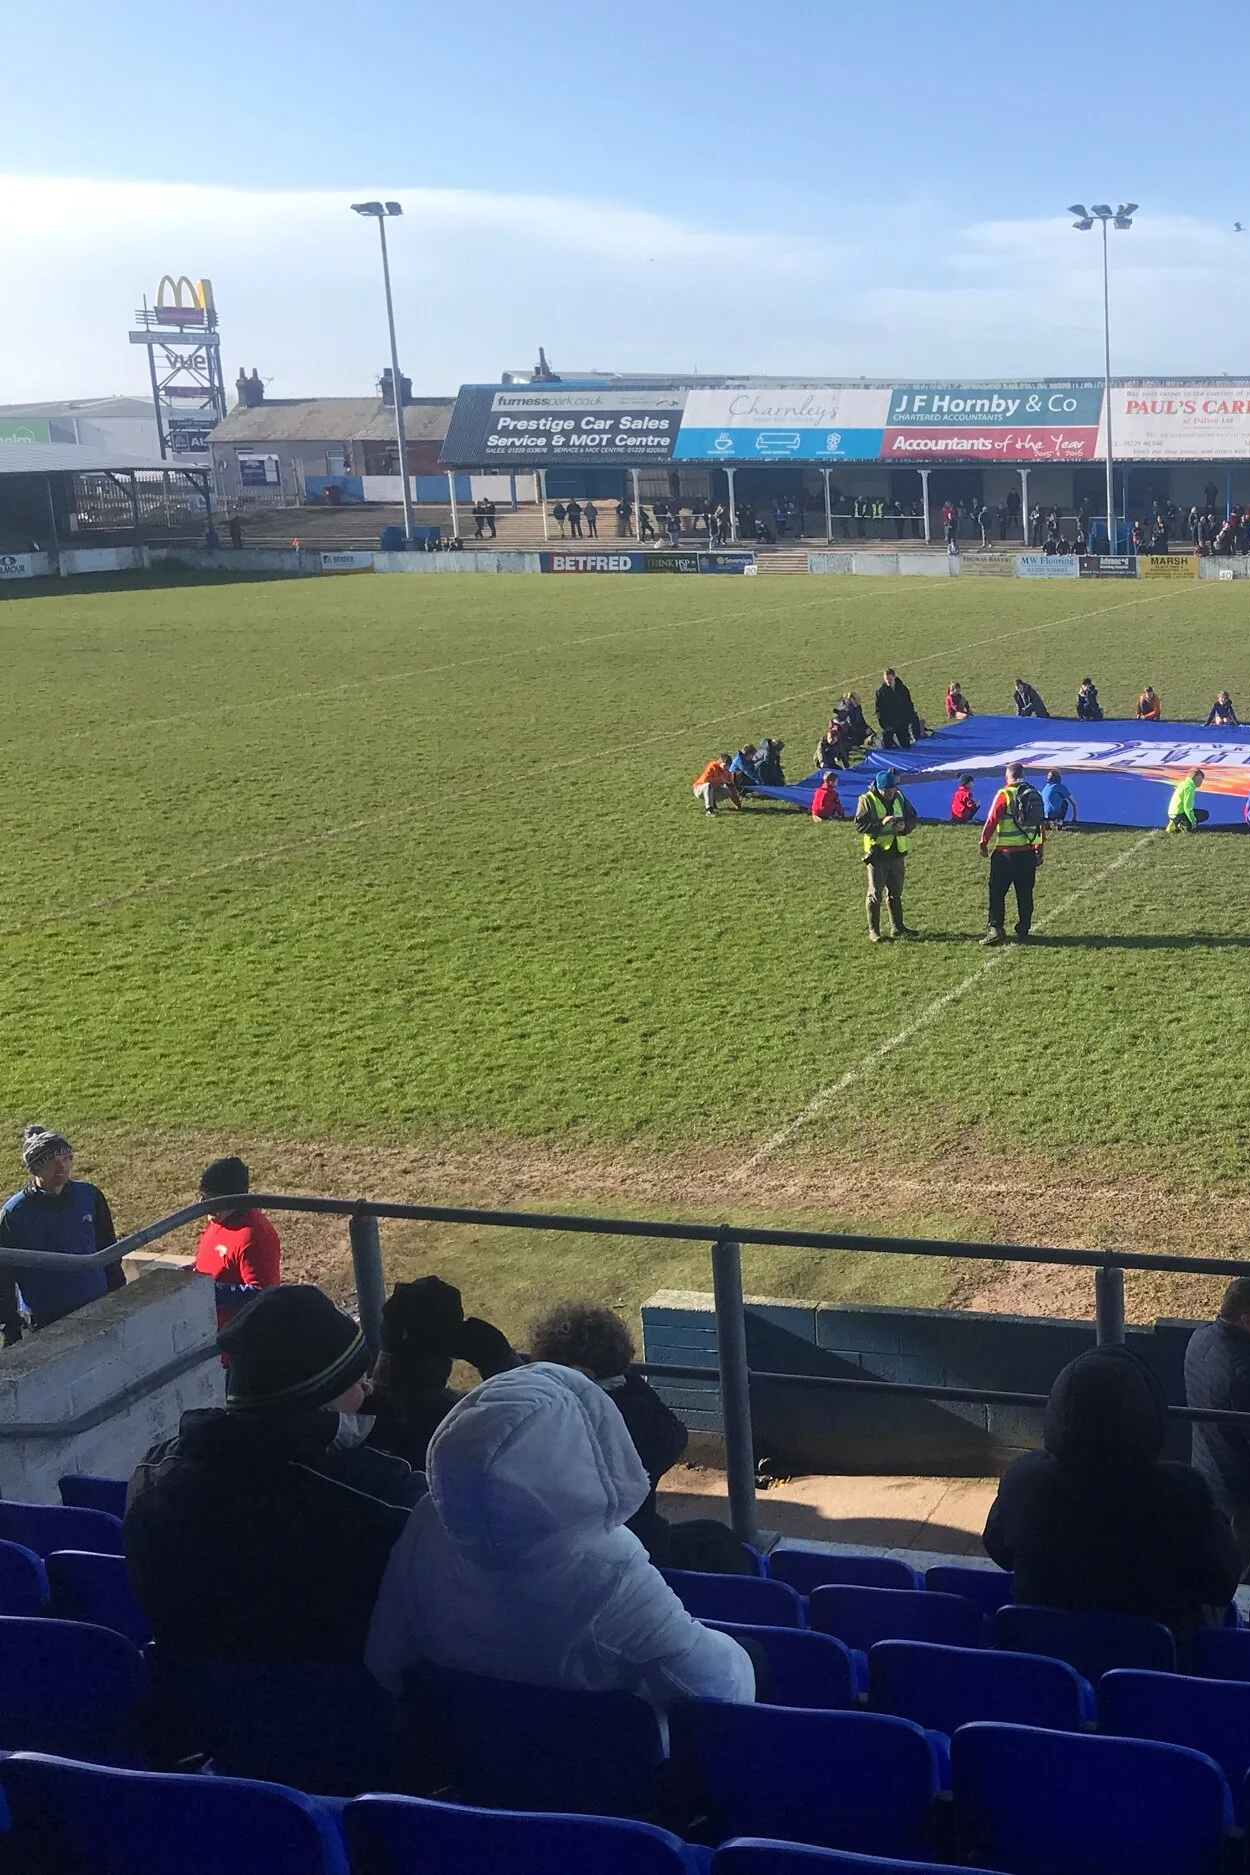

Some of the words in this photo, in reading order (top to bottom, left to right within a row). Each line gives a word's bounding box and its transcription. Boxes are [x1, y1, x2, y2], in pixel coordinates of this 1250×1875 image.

[166, 354, 206, 370] vue
[895, 395, 908, 413] J
[913, 395, 928, 413] F
[931, 394, 1021, 417] Hornby
[1025, 394, 1041, 412] &
[1048, 394, 1077, 412] Co
[1125, 399, 1196, 415] PAUL'S
[497, 416, 575, 433] Prestige
[580, 416, 614, 430] Car
[618, 415, 670, 430] Sales
[487, 434, 547, 446] Service
[551, 434, 566, 446] &
[569, 434, 612, 446] MOT
[615, 433, 671, 446] Centre
[892, 436, 992, 451] Accountants
[994, 434, 1013, 450] of
[1015, 434, 1045, 454] the
[1050, 434, 1085, 450] Year
[553, 556, 632, 571] BETFRED
[1021, 557, 1039, 565] MW
[1040, 556, 1074, 566] Flooring
[1151, 557, 1188, 565] MARSH
[746, 567, 757, 575] 20
[1220, 571, 1232, 579] 40
